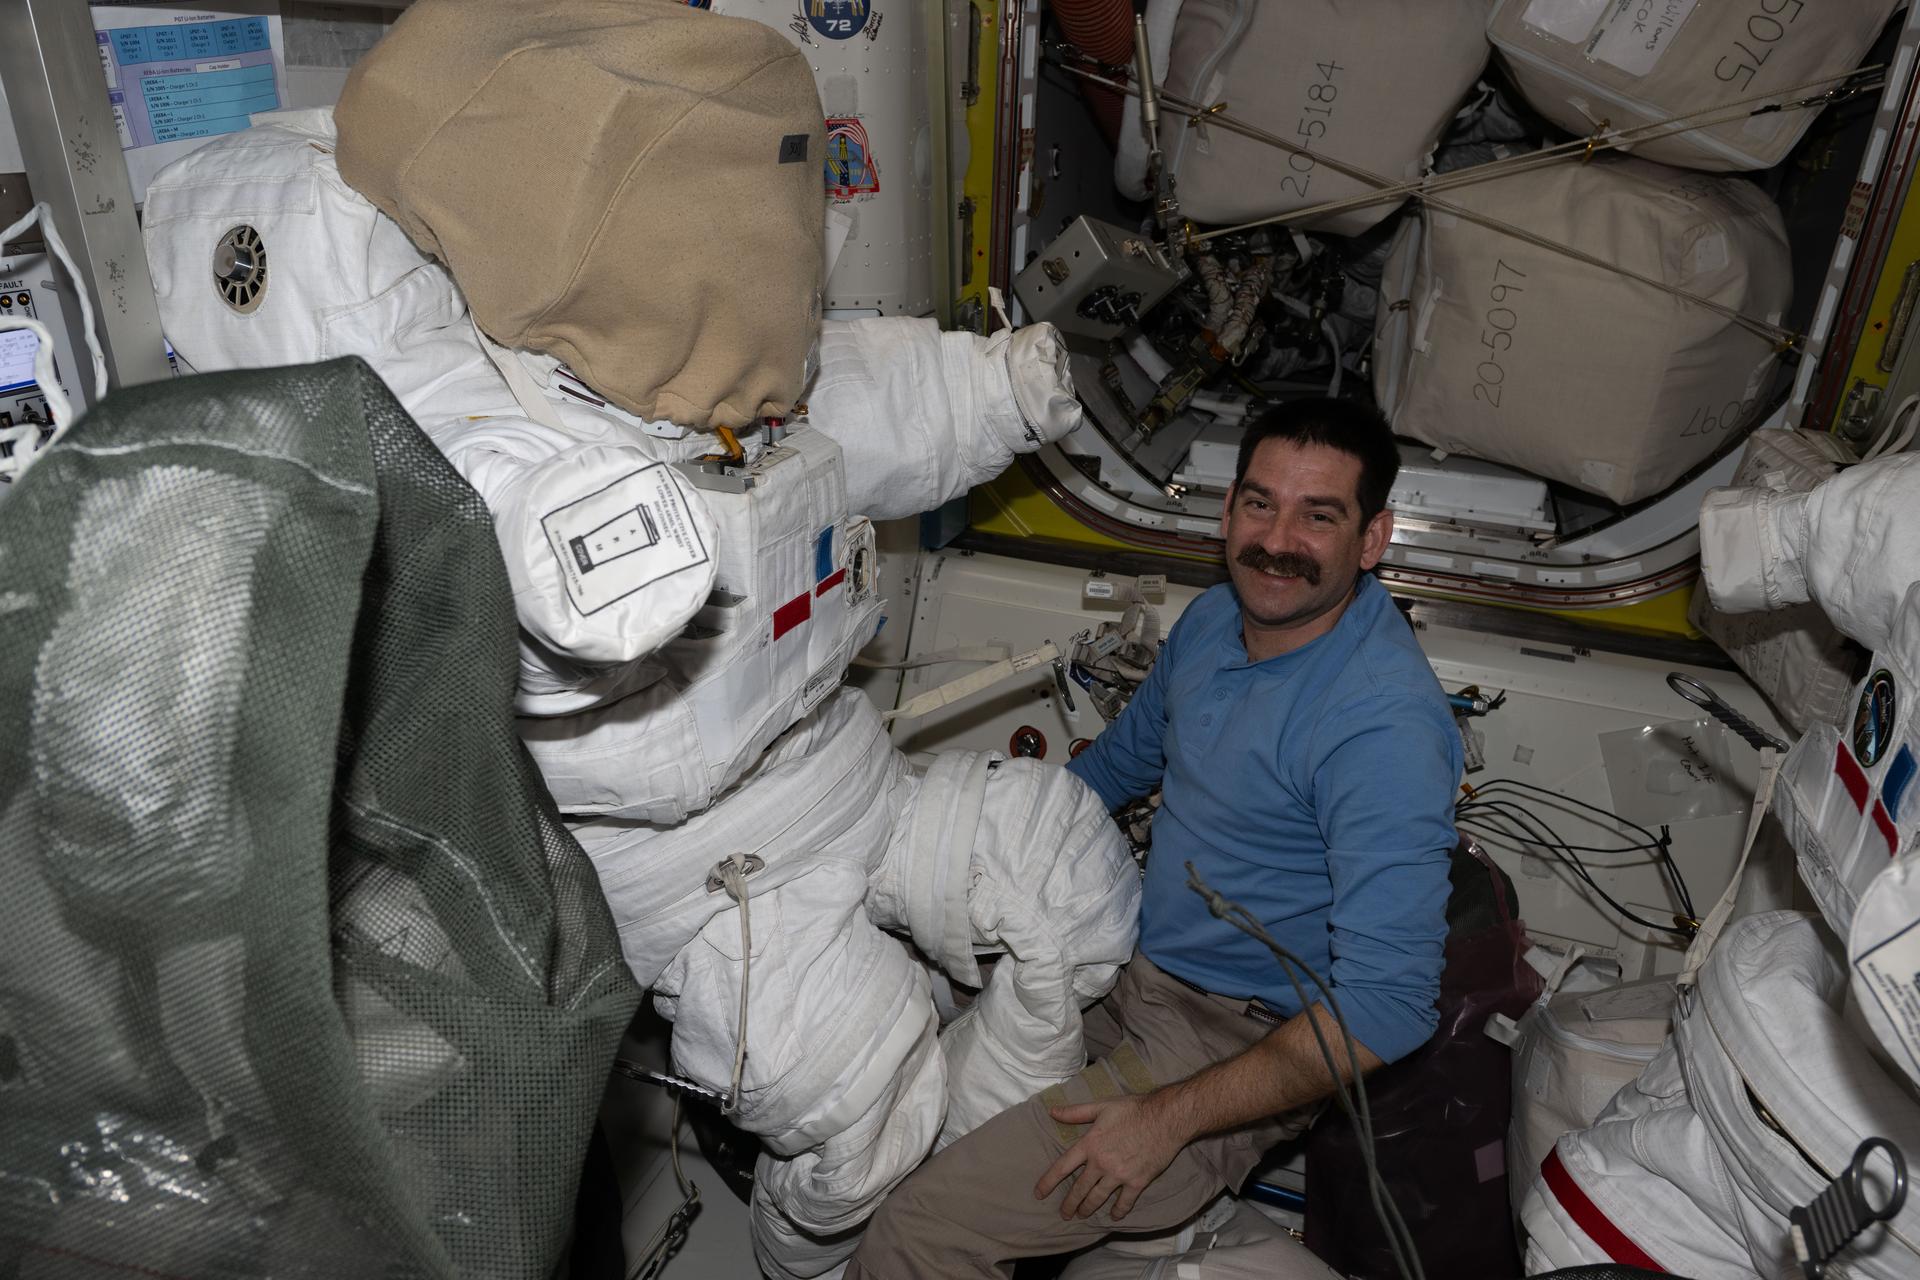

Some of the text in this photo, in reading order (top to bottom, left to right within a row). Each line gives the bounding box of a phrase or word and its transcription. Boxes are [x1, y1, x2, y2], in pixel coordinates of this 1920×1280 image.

[826, 19, 851, 31] 72
[1472, 258, 1527, 408] 20-5097
[656, 485, 669, 508] LOWER
[684, 537, 697, 559] COVER
